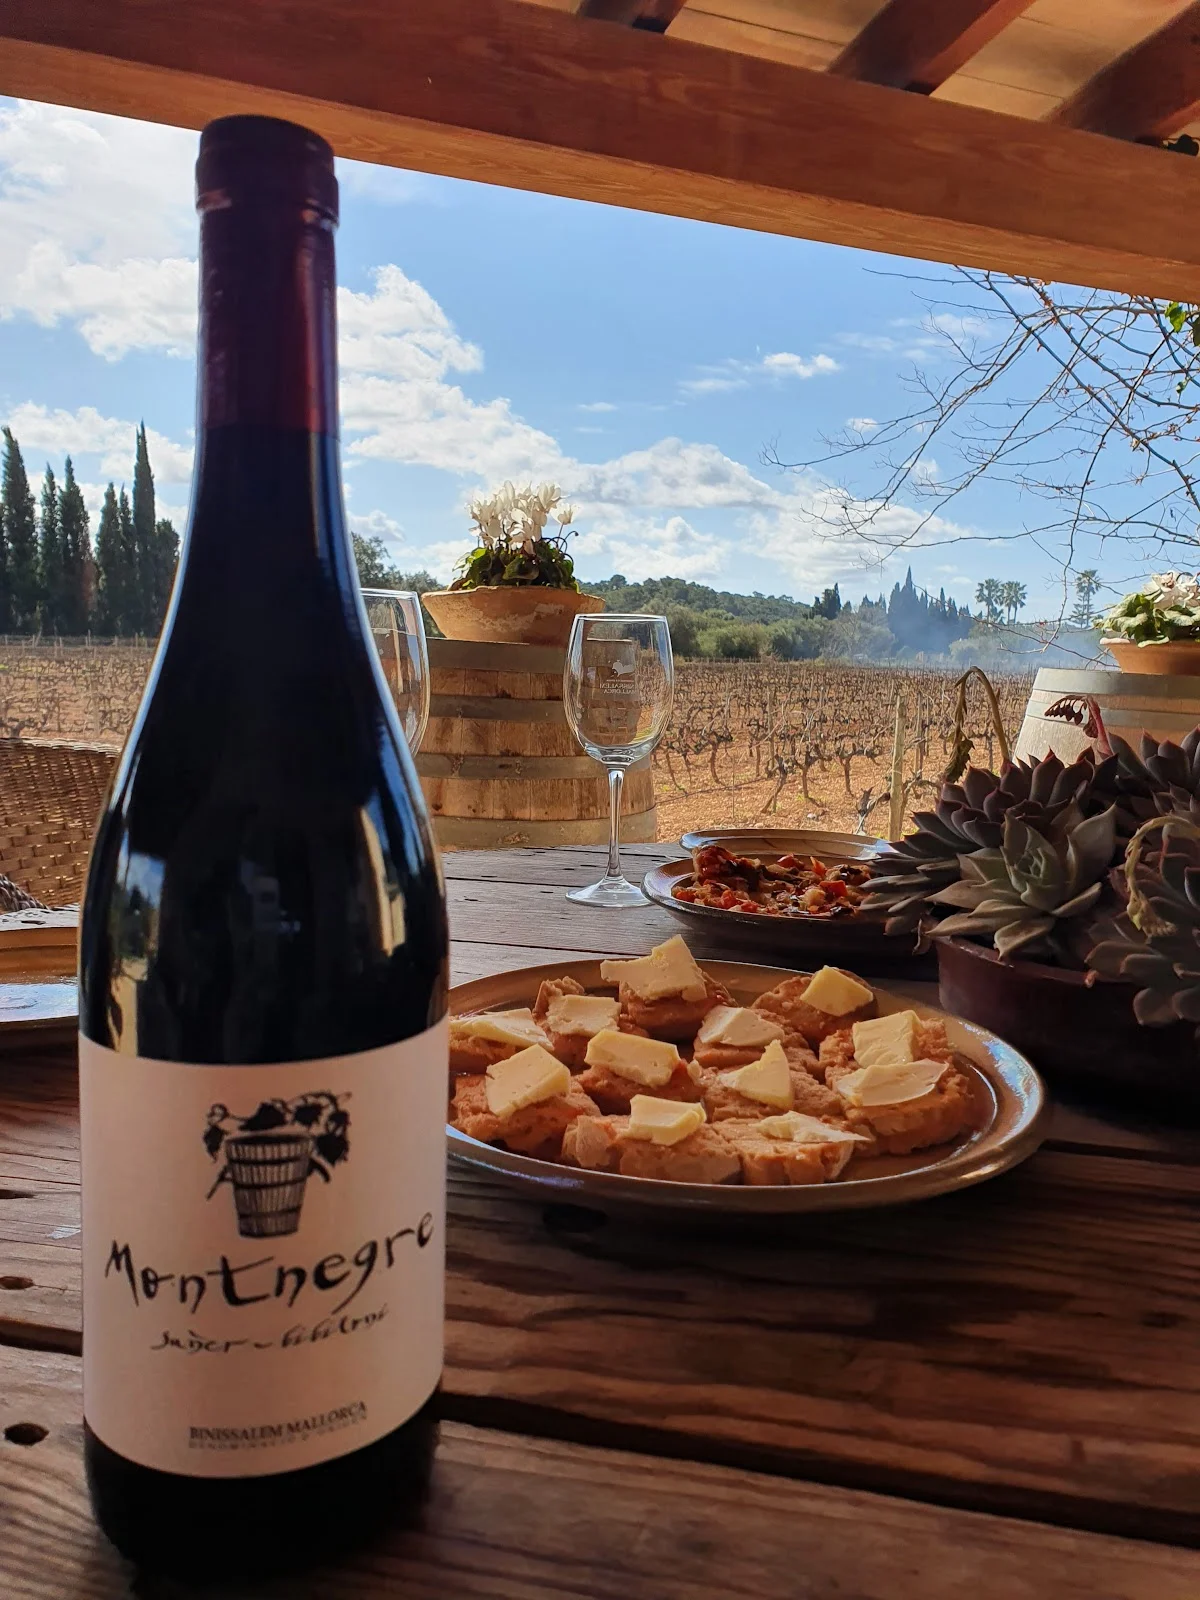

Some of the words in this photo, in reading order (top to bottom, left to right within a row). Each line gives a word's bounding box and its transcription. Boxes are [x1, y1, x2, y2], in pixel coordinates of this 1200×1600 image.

[104, 1212, 434, 1315] Montnegre
[190, 1425, 282, 1443] BINISSALEM
[287, 1402, 366, 1436] MALLORCA
